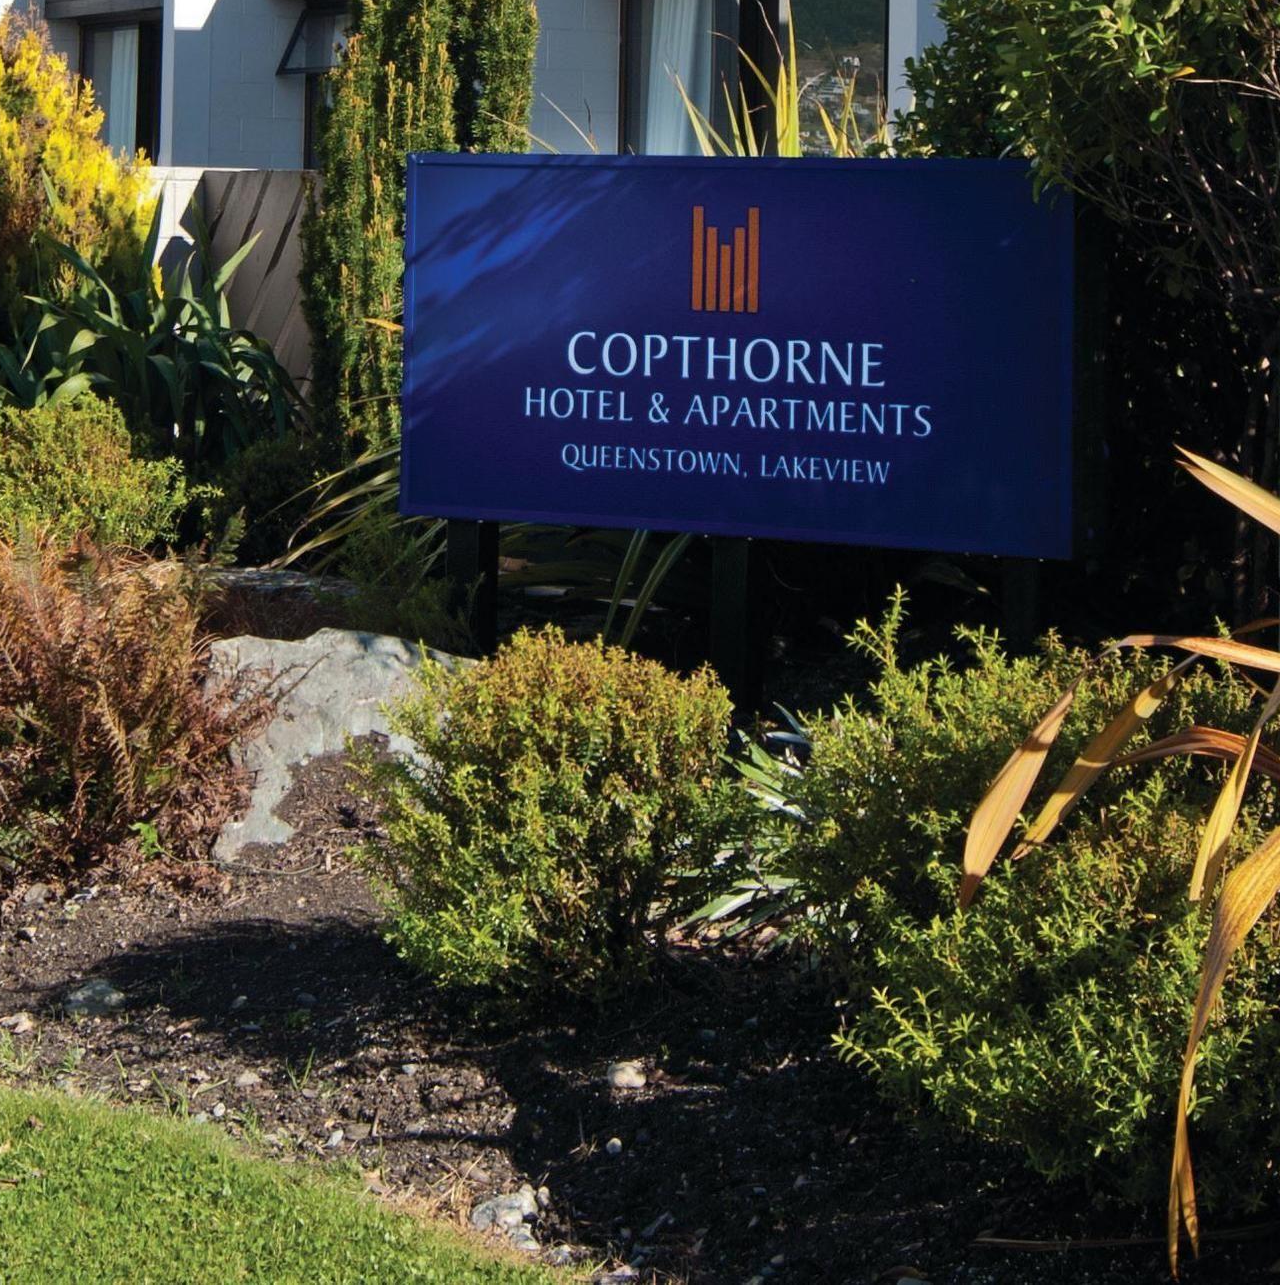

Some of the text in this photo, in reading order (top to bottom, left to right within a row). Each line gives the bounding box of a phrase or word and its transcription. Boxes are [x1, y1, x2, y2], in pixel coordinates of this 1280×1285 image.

[566, 331, 886, 387] COPTHORNE
[524, 387, 933, 437] HOTEL & APARTMENTS
[561, 443, 891, 484] QUEENSTOWN, LAKEVIEW
